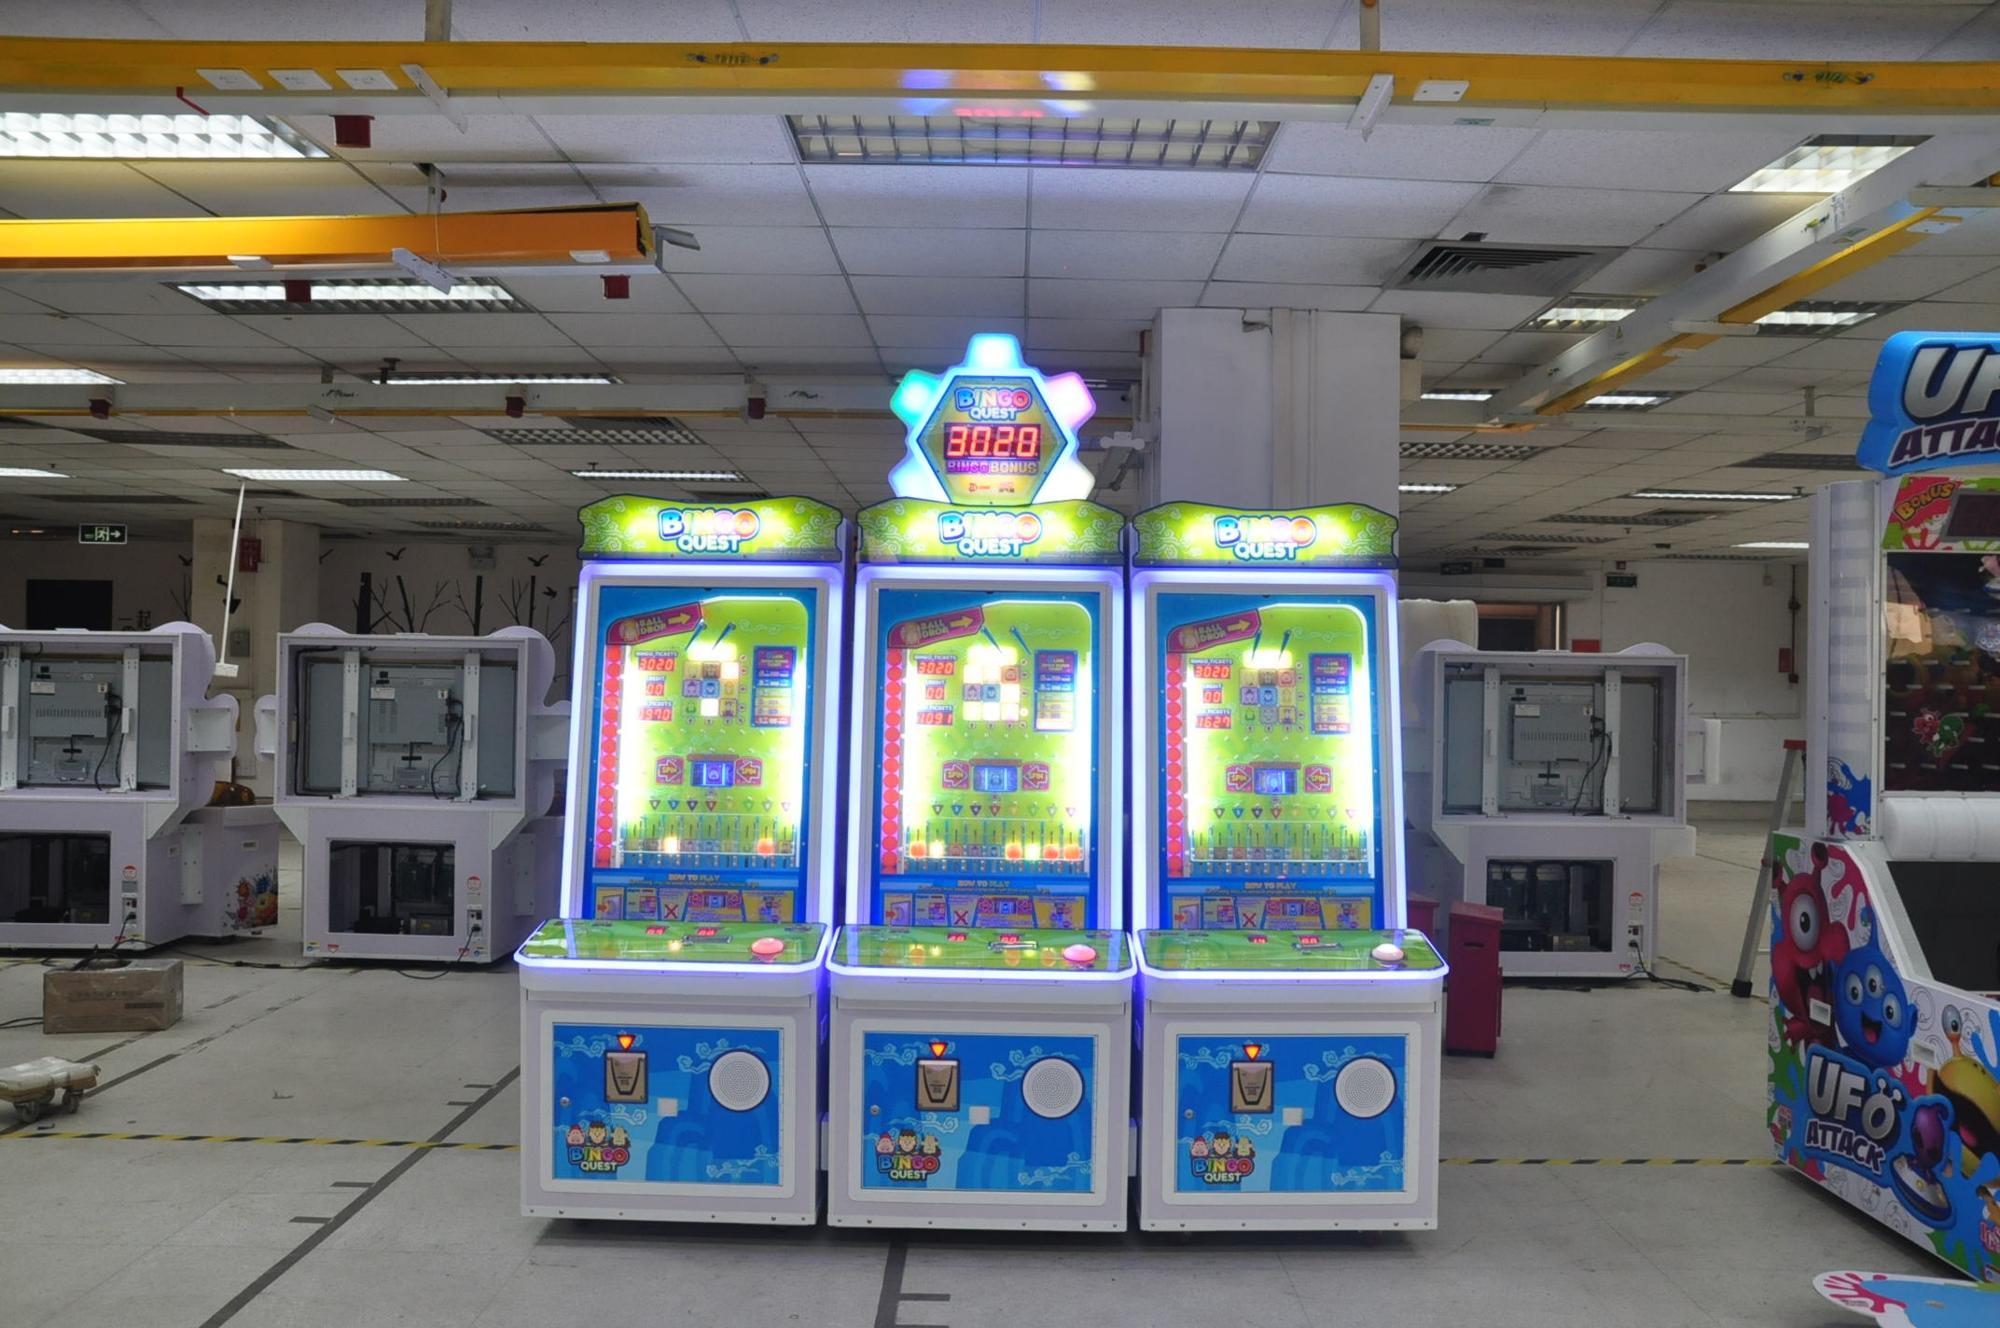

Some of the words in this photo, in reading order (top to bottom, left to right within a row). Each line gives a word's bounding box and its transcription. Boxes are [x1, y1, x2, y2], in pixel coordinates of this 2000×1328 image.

[956, 388, 1031, 410] BINGO
[970, 408, 1017, 419] QUEST
[946, 426, 1038, 457] 3020
[1888, 420, 2000, 467] ATTA
[990, 461, 1037, 474] BONUS
[1895, 482, 1954, 520] BONUS
[661, 511, 758, 538] BINGO
[941, 514, 1039, 541] BINGO
[1217, 517, 1315, 546] BINGO
[678, 536, 742, 552] QUEST
[958, 540, 1023, 556] QUEST
[1235, 544, 1298, 559] QUEST
[640, 623, 667, 635] DROP
[639, 658, 674, 670] 3020
[918, 662, 953, 674] 3020
[1195, 666, 1229, 678] 3020
[647, 684, 664, 695] 00
[926, 688, 944, 699] 00
[1204, 692, 1221, 703] 00
[639, 708, 671, 720] 1970
[919, 713, 952, 725] 1091
[1198, 717, 1230, 728] 1627
[1805, 1118, 1884, 1173] ATTACK
[570, 1146, 628, 1163] BINGO
[580, 1161, 617, 1171] QUEST
[879, 1155, 939, 1170] BINGO
[1193, 1158, 1253, 1174] BINGO
[890, 1169, 927, 1180] QUEST
[1204, 1172, 1241, 1183] QUEST
